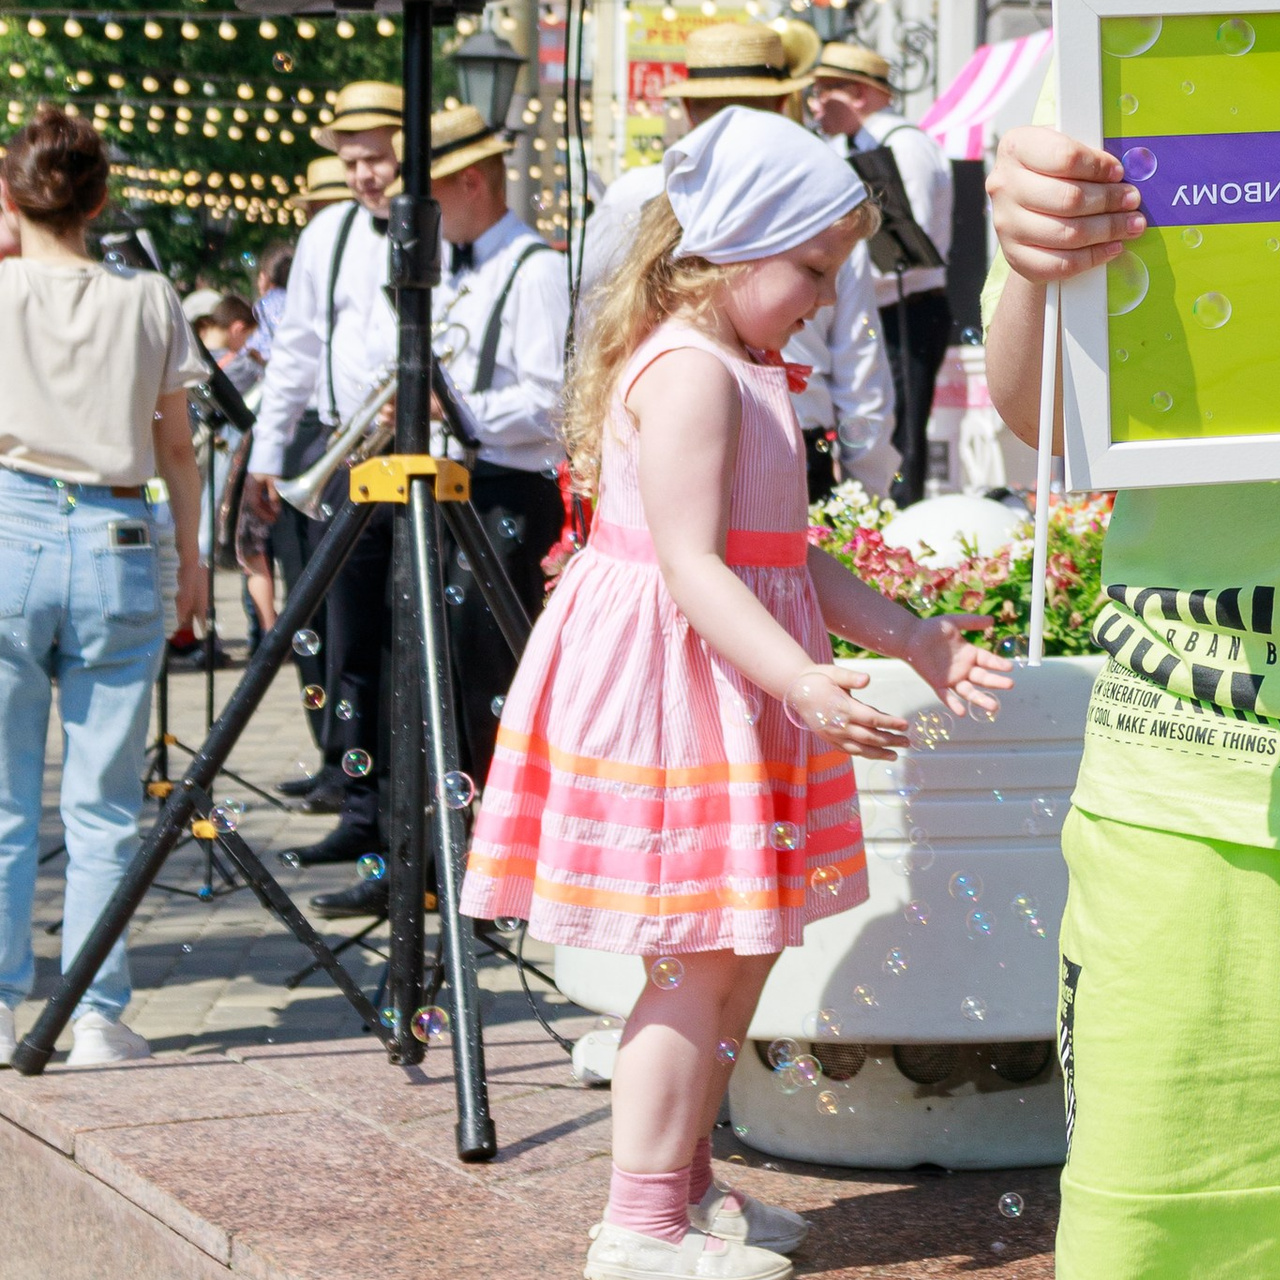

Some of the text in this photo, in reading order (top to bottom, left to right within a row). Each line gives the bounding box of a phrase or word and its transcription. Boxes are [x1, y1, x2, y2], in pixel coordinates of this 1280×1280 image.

[1164, 627, 1241, 662] RBAN
[1103, 681, 1162, 710] GENERATION
[1115, 713, 1147, 736] MAKE
[1149, 719, 1215, 747] AWESOME
[1221, 730, 1277, 756] THINGS
